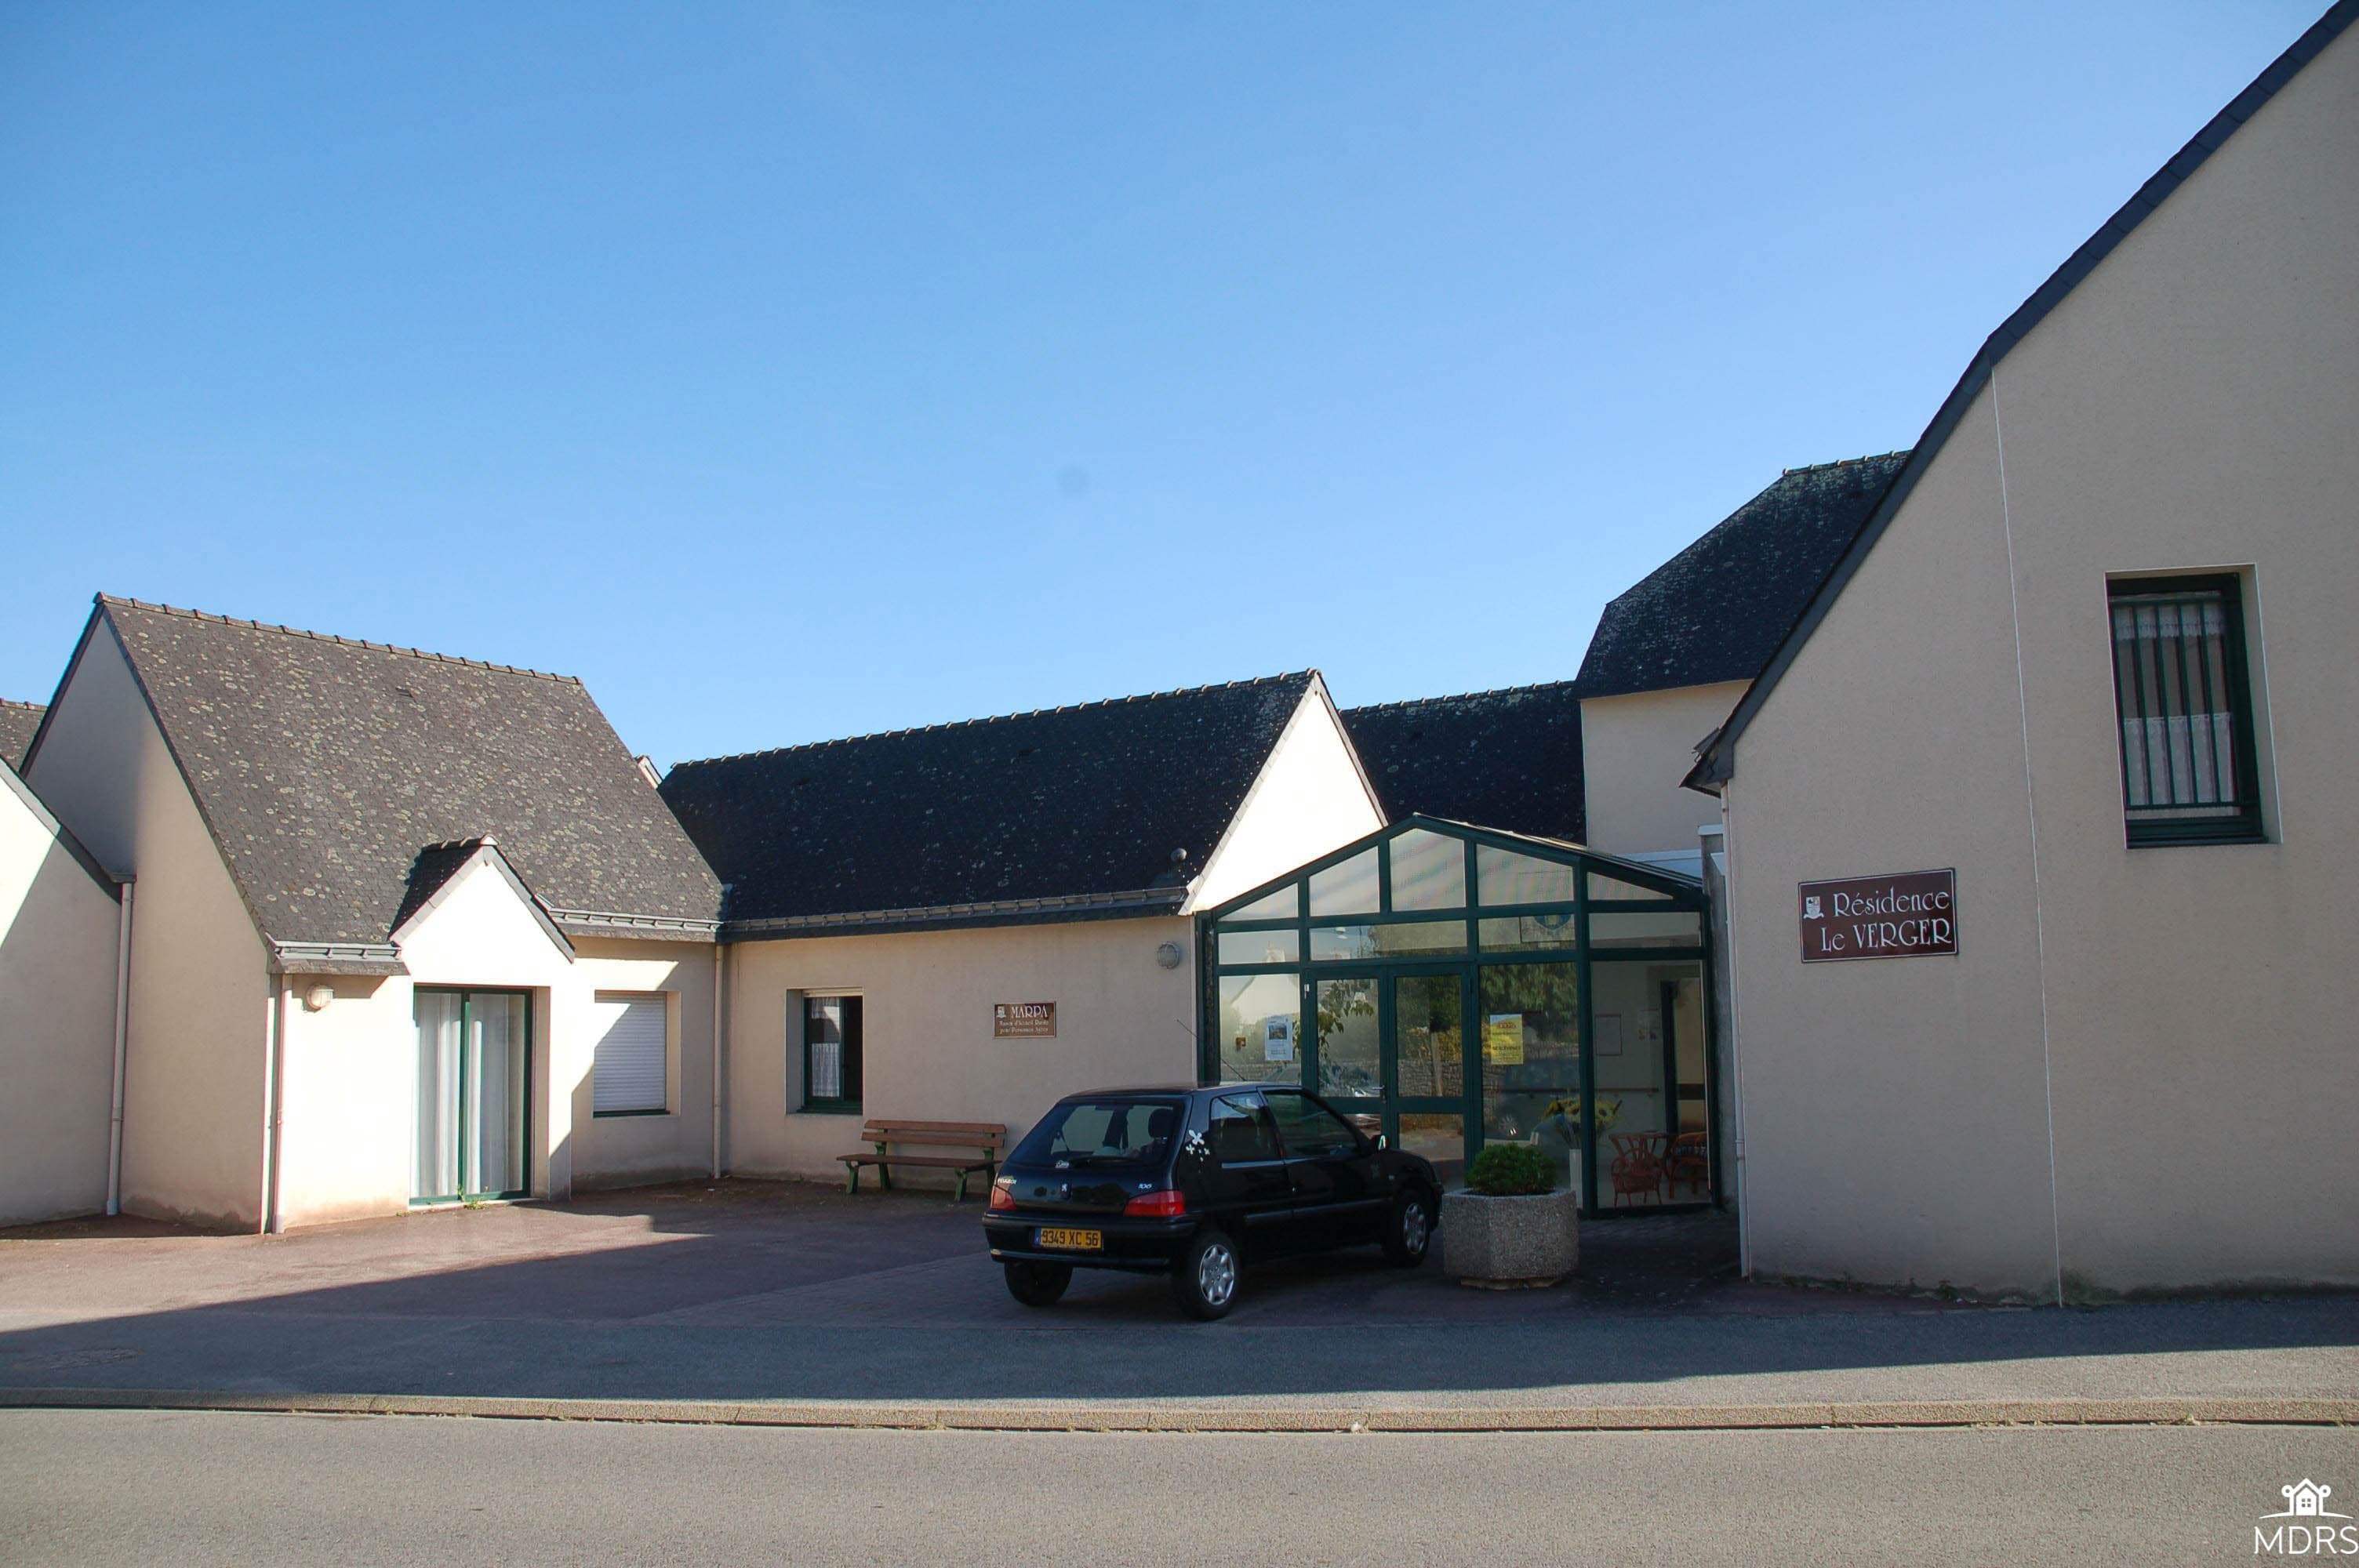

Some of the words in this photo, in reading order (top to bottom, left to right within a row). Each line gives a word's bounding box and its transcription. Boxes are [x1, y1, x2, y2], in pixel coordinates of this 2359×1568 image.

[1833, 886, 1950, 916] Résidence
[1821, 927, 1845, 953] Le
[1852, 917, 1952, 949] VERGER
[1011, 1005, 1048, 1018] MARPA
[1042, 1230, 1066, 1244] 9349
[1069, 1231, 1082, 1245] XC
[1085, 1232, 1099, 1246] 56
